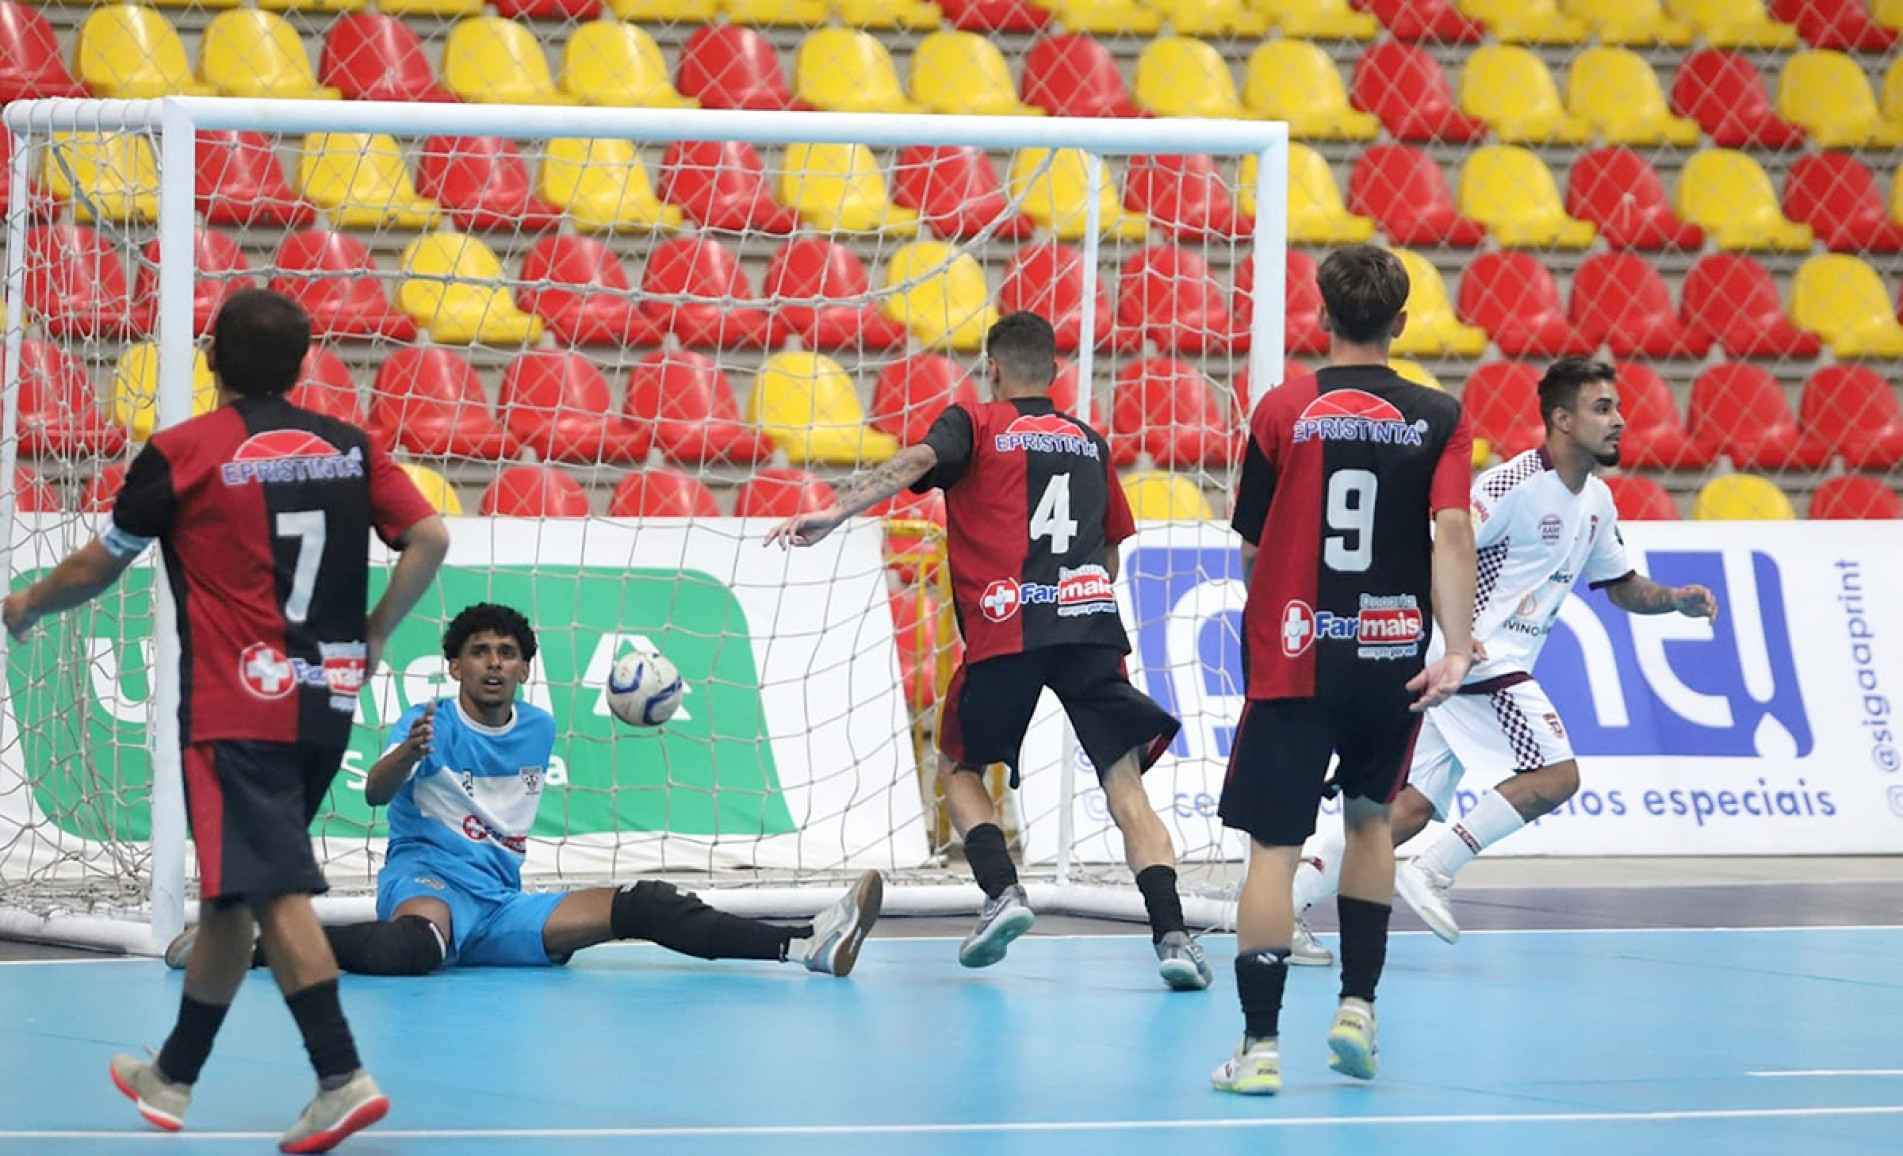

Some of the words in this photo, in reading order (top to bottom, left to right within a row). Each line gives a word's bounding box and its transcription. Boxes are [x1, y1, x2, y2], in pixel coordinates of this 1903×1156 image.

[1030, 472, 1078, 553] 4
[1324, 468, 1378, 572] 9
[276, 510, 326, 622] 7
[1834, 560, 1900, 773] @sigaaprint
[1643, 778, 1836, 827] especiais
